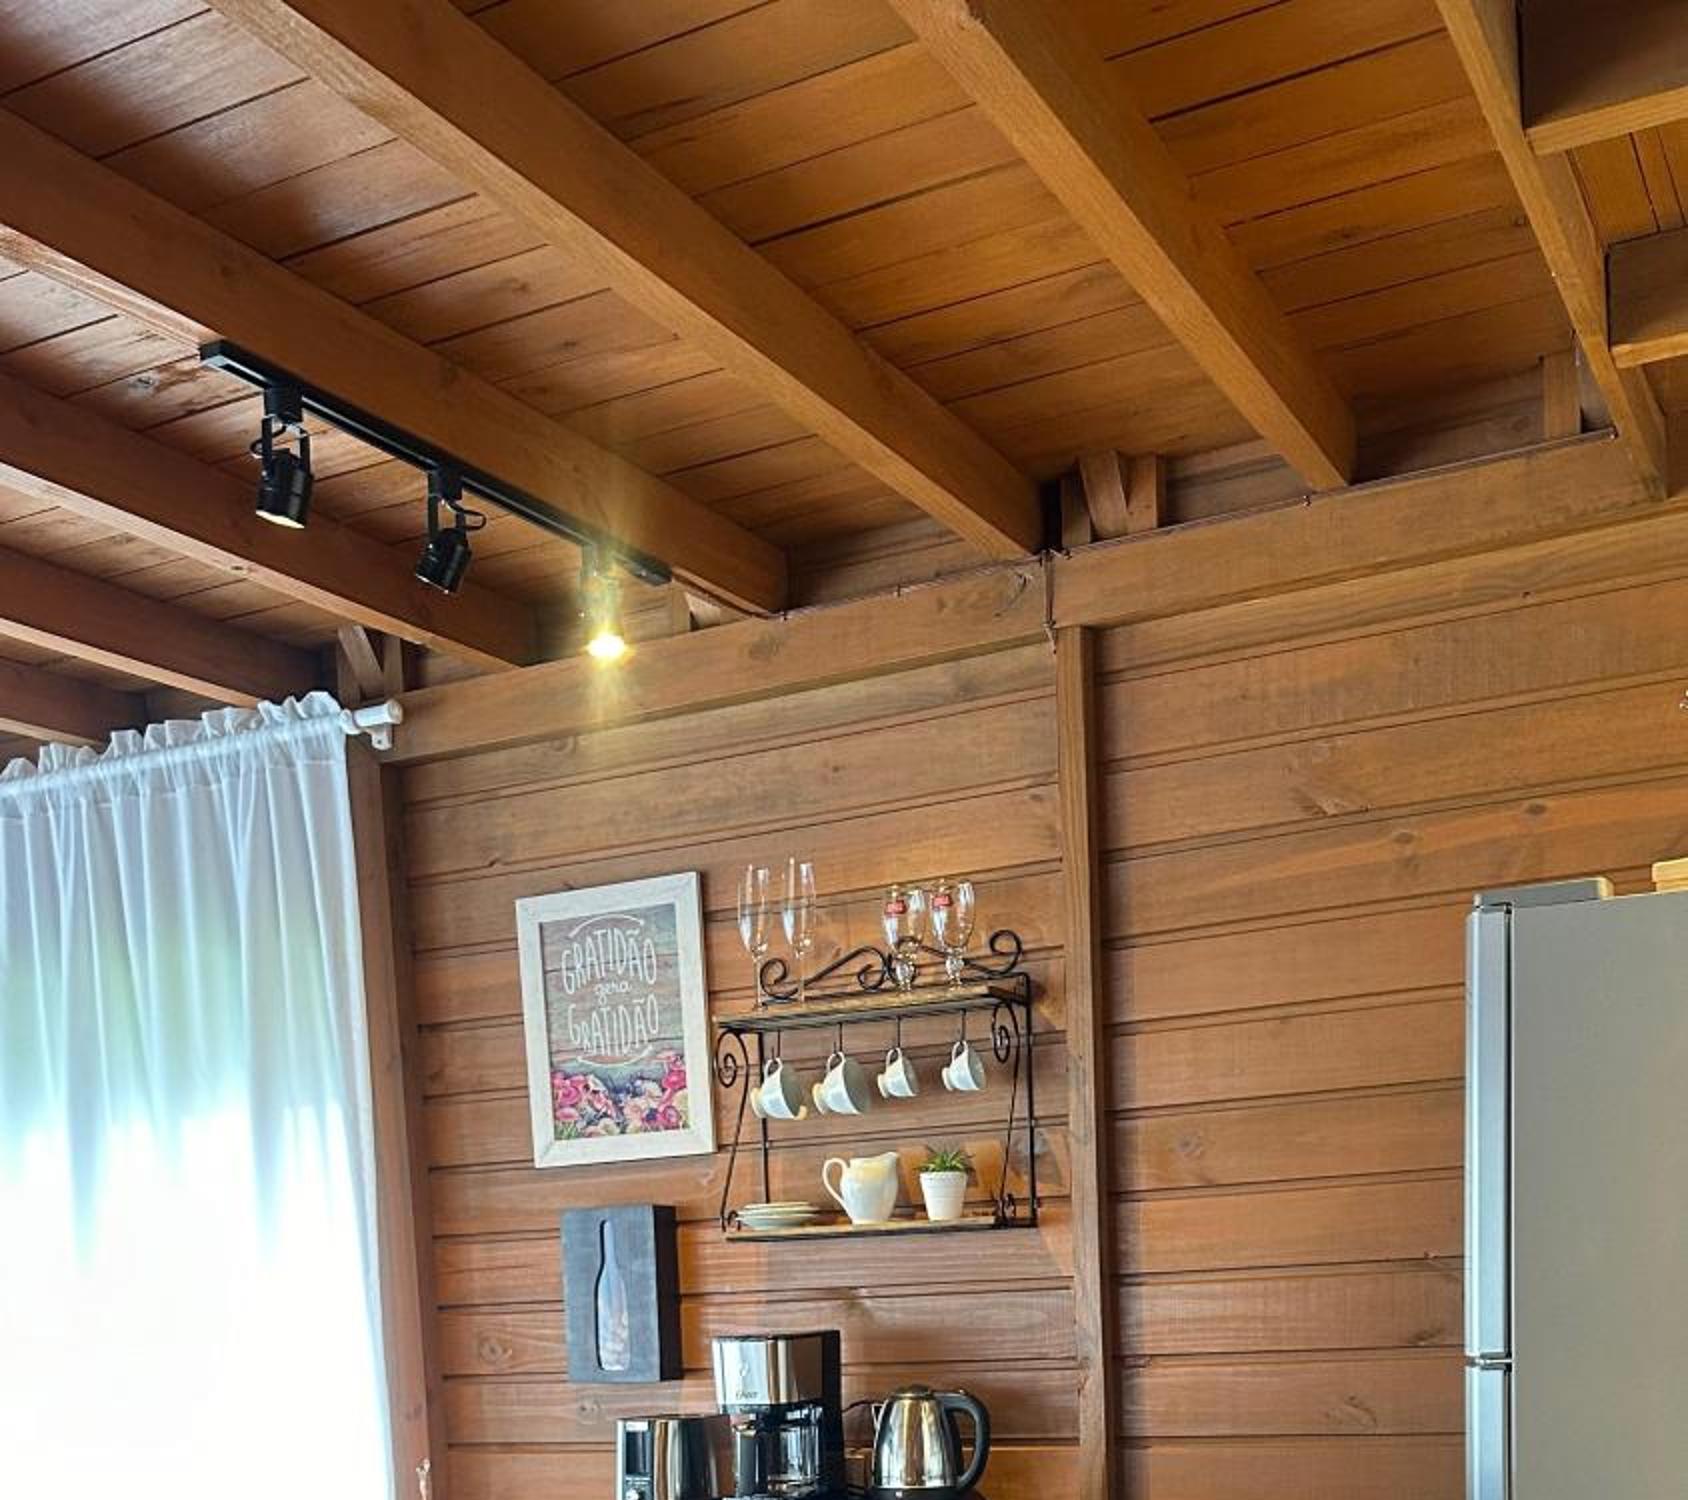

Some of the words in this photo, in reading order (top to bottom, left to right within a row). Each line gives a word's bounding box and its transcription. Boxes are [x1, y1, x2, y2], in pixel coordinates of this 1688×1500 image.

[561, 927, 657, 995] GRATIDÃO
[595, 980, 631, 1005] gera
[568, 993, 659, 1057] GRATIDÃO
